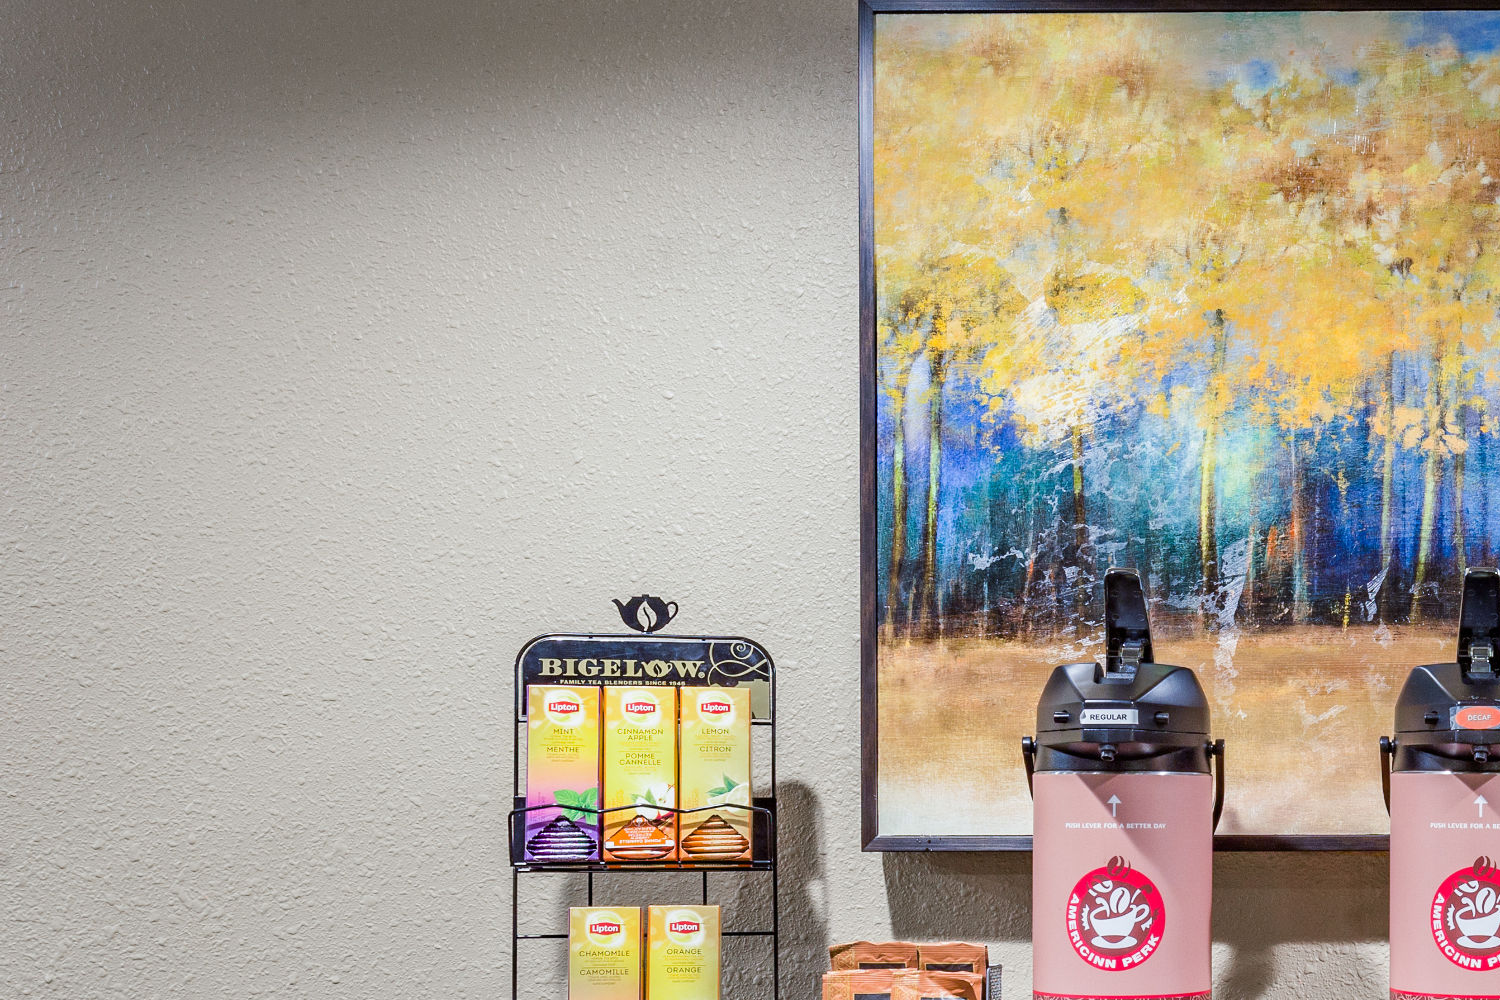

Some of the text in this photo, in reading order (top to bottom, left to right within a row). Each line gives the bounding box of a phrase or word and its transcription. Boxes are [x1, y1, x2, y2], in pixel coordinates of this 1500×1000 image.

[550, 703, 578, 712] Lipton
[627, 704, 654, 712] Lipton
[703, 704, 729, 712] Lipton
[592, 924, 619, 933] Lipton
[671, 923, 698, 931] Lipton
[1066, 893, 1160, 969] AMERICINN PERK
[1432, 892, 1482, 969] AMERICINN
